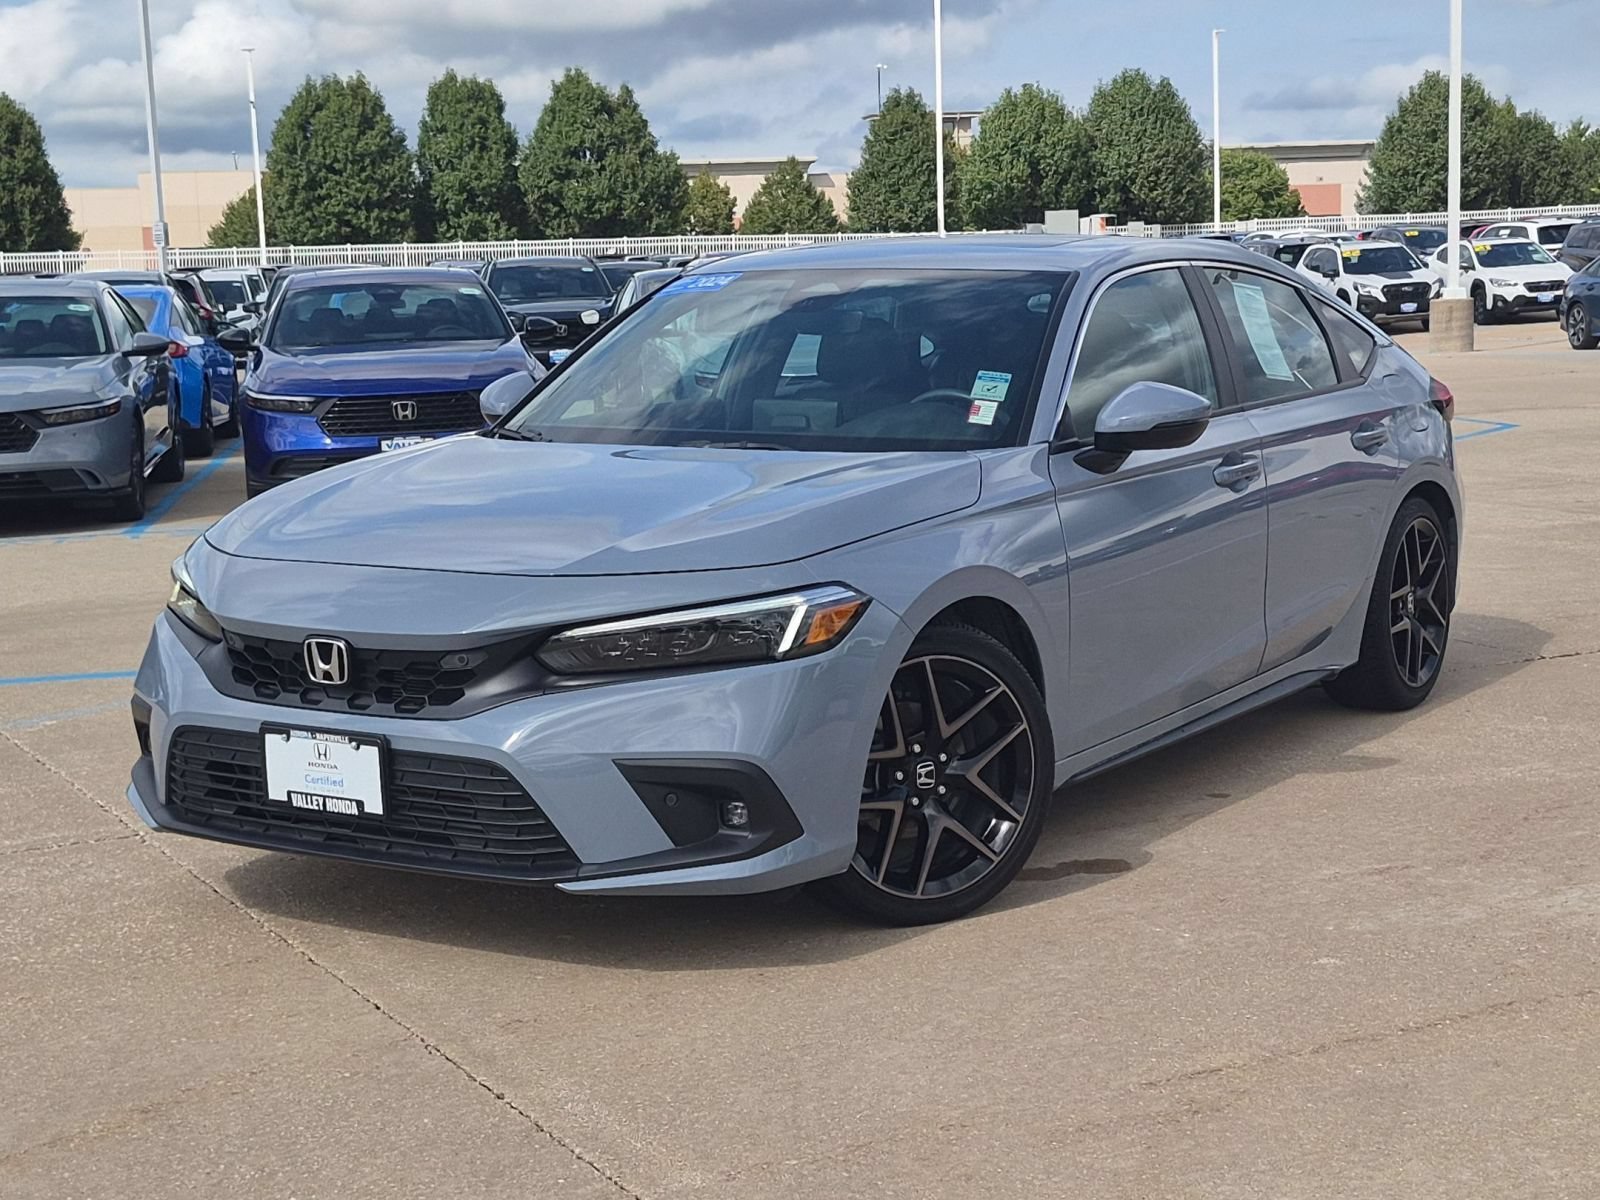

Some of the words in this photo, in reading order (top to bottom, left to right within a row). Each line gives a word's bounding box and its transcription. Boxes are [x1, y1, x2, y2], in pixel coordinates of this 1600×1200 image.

[308, 761, 339, 770] HONDA
[304, 773, 344, 788] Certified
[290, 792, 324, 811] VALLEY
[325, 797, 359, 816] HONDA
